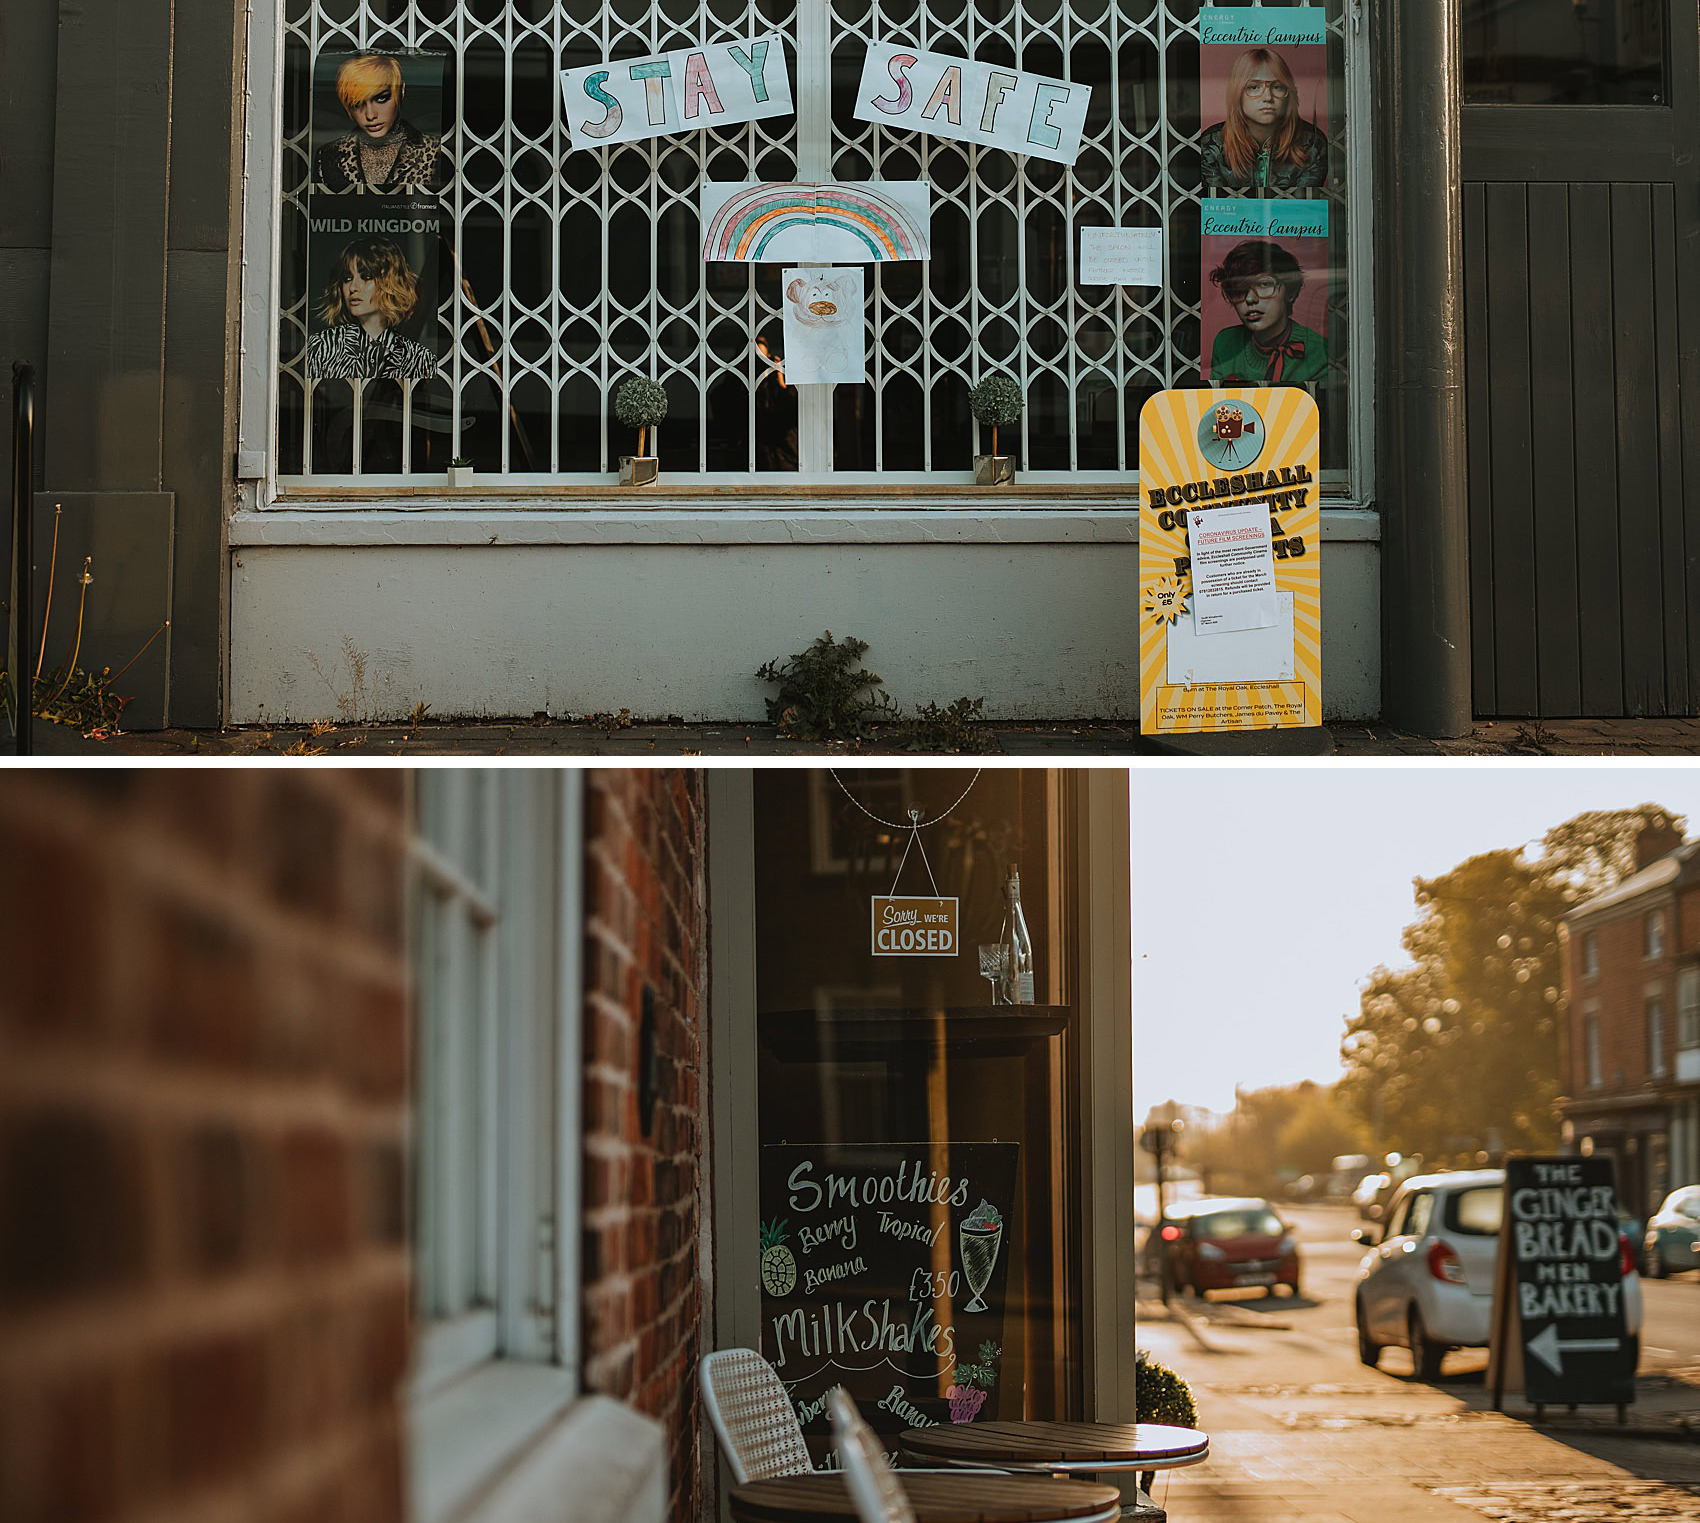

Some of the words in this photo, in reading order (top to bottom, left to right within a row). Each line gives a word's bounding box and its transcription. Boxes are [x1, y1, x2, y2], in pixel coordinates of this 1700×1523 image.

[1203, 27, 1262, 44] Eccentric
[1266, 27, 1323, 48] Campus
[580, 41, 769, 139] STAY
[870, 54, 1070, 149] SAFE
[310, 219, 353, 233] WILD
[358, 219, 440, 233] KINGDOM
[1204, 217, 1264, 235] Eccentric
[1268, 219, 1325, 240] Campus
[1148, 465, 1312, 508] ECCLESHALL
[1158, 487, 1308, 529] COITY
[1199, 529, 1236, 538] CORONAVIRUS
[1237, 527, 1258, 535] UPDATE
[1232, 532, 1265, 541] SCREENINGS
[1157, 591, 1176, 599] Only
[883, 905, 922, 928] Sorry
[924, 915, 948, 923] WE'RE
[878, 929, 952, 950] CLOSED
[788, 1161, 968, 1211] Smoothies
[1534, 1165, 1582, 1181] THE
[1512, 1187, 1617, 1220] GINGER
[798, 1215, 856, 1253] Berry
[877, 1211, 945, 1247] Tropical
[1516, 1221, 1618, 1259] BREAD
[804, 1256, 868, 1294] Banana
[909, 1267, 960, 1301] £3.50
[1538, 1262, 1590, 1280] MEN
[1520, 1281, 1620, 1318] BAKERY
[878, 1385, 940, 1427] Bana
